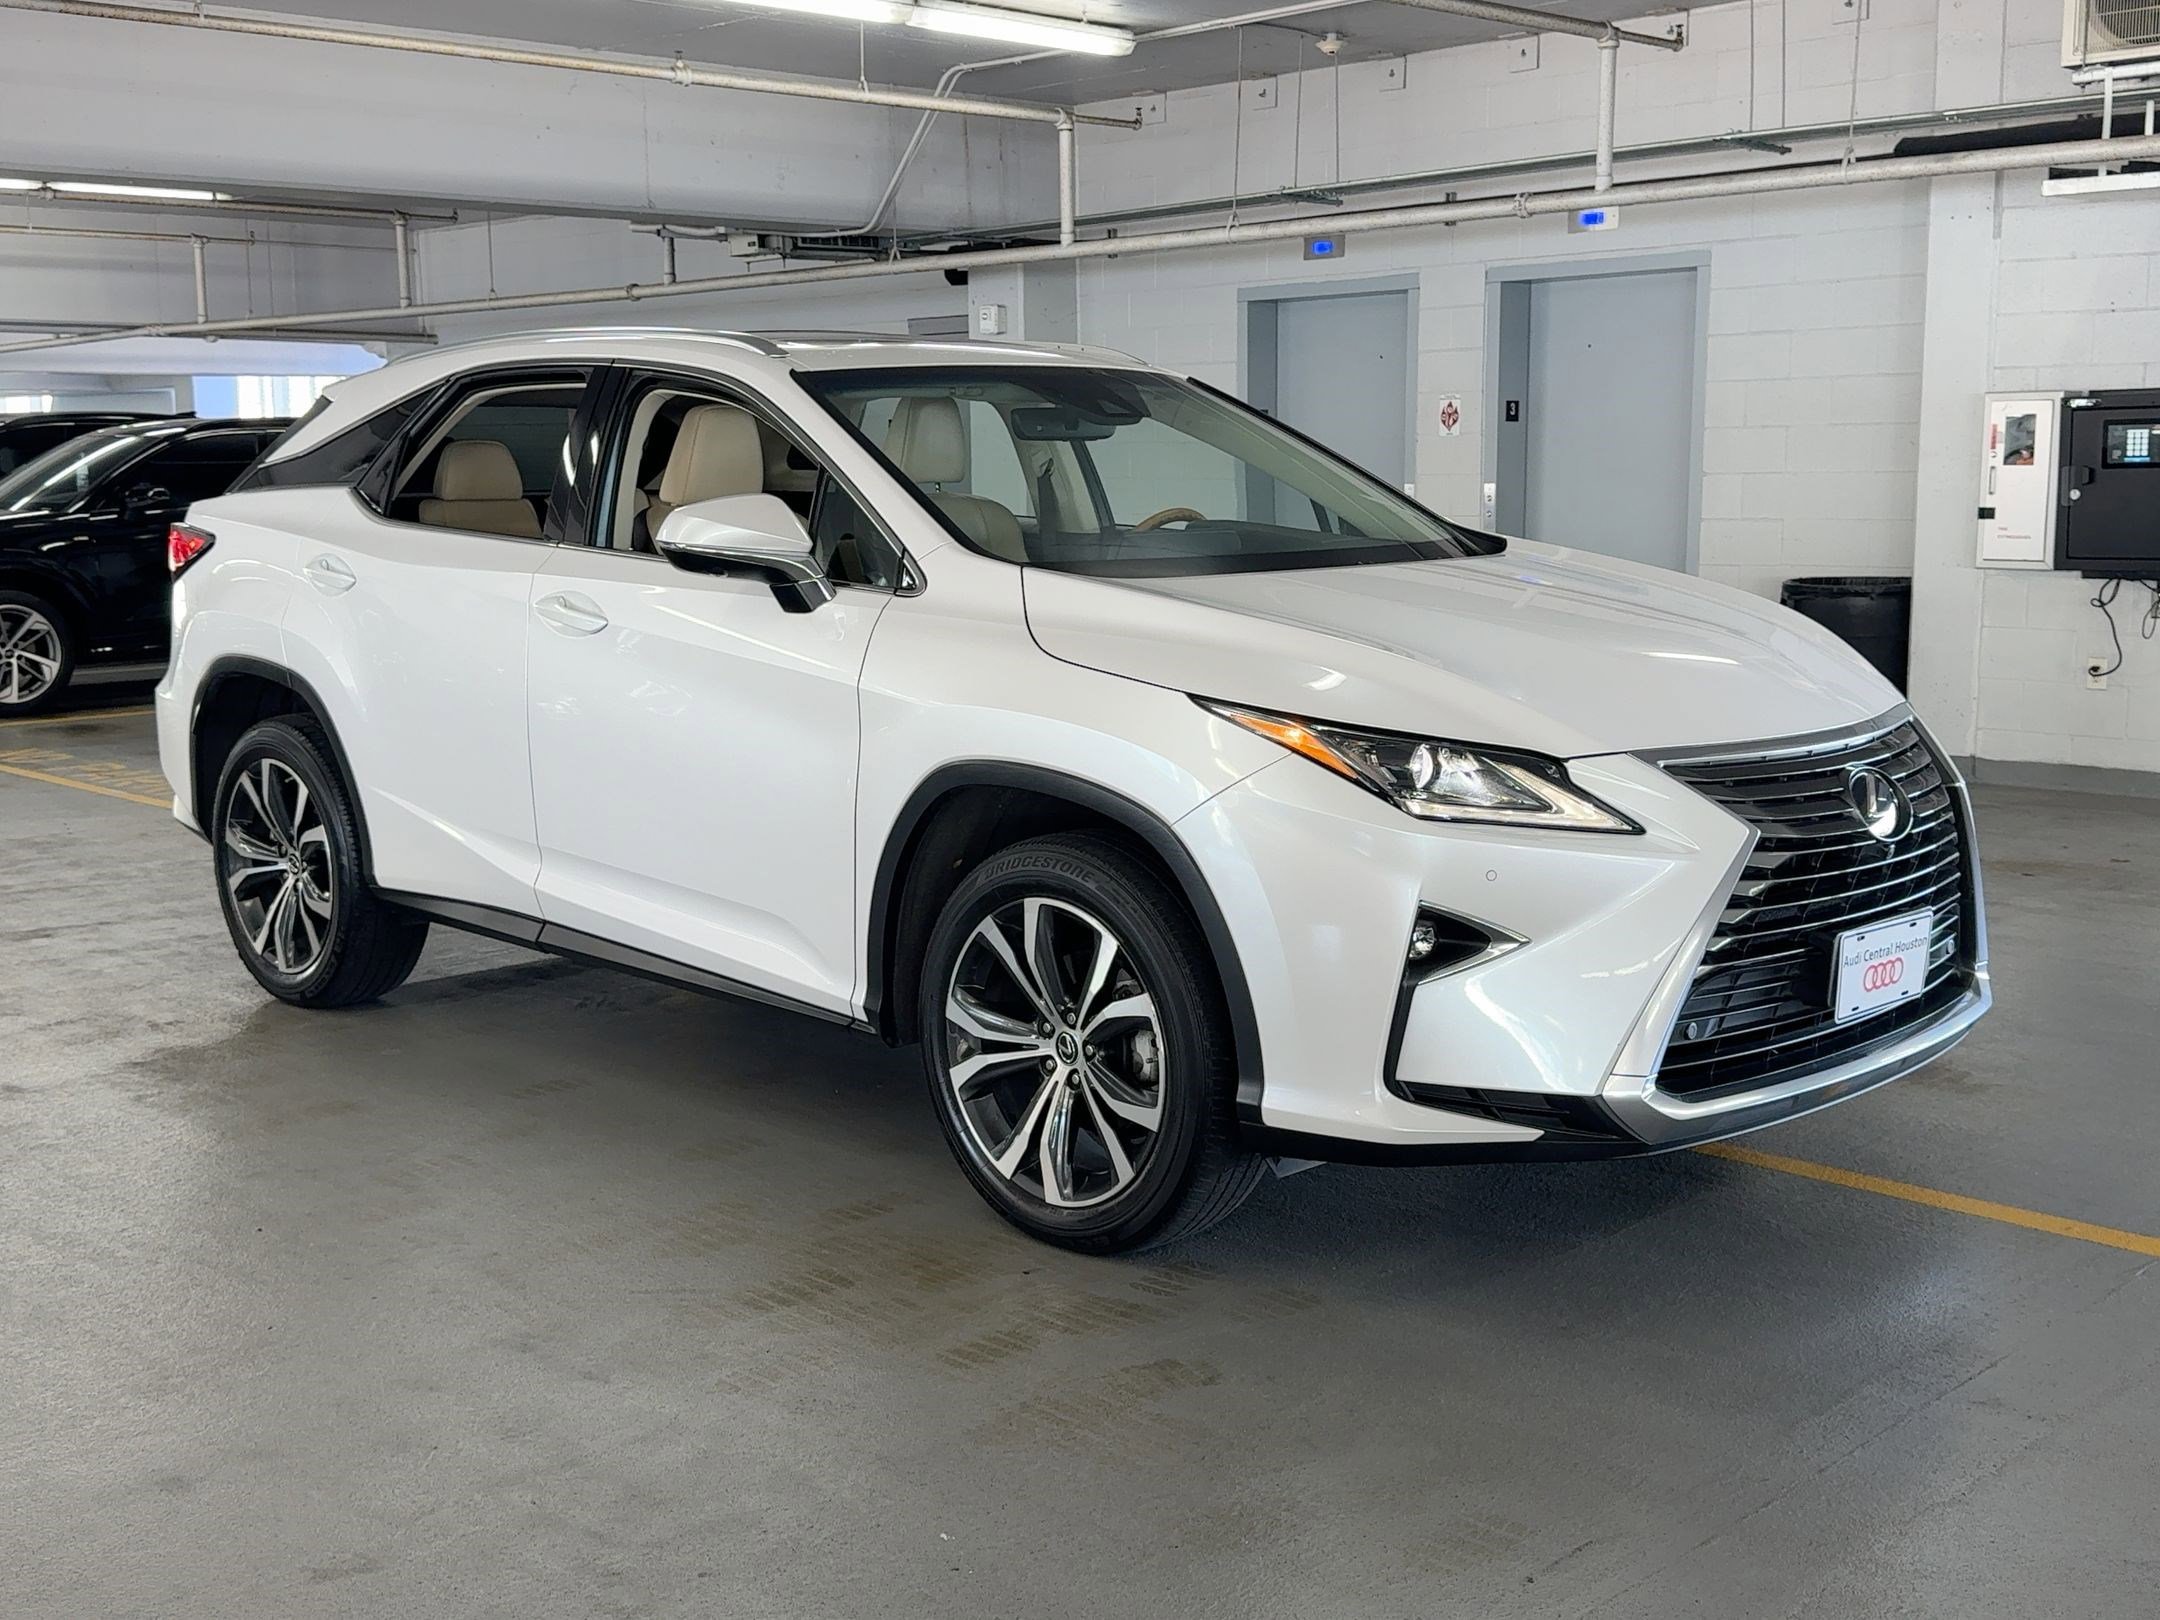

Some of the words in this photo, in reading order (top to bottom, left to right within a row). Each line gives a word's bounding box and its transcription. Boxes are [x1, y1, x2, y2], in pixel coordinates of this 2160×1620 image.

[1510, 402, 1516, 415] 3
[984, 855, 1094, 883] BRIDGESTONE
[1843, 954, 1861, 968] Audi
[1863, 943, 1893, 961] Central
[1895, 937, 1927, 954] Houston
